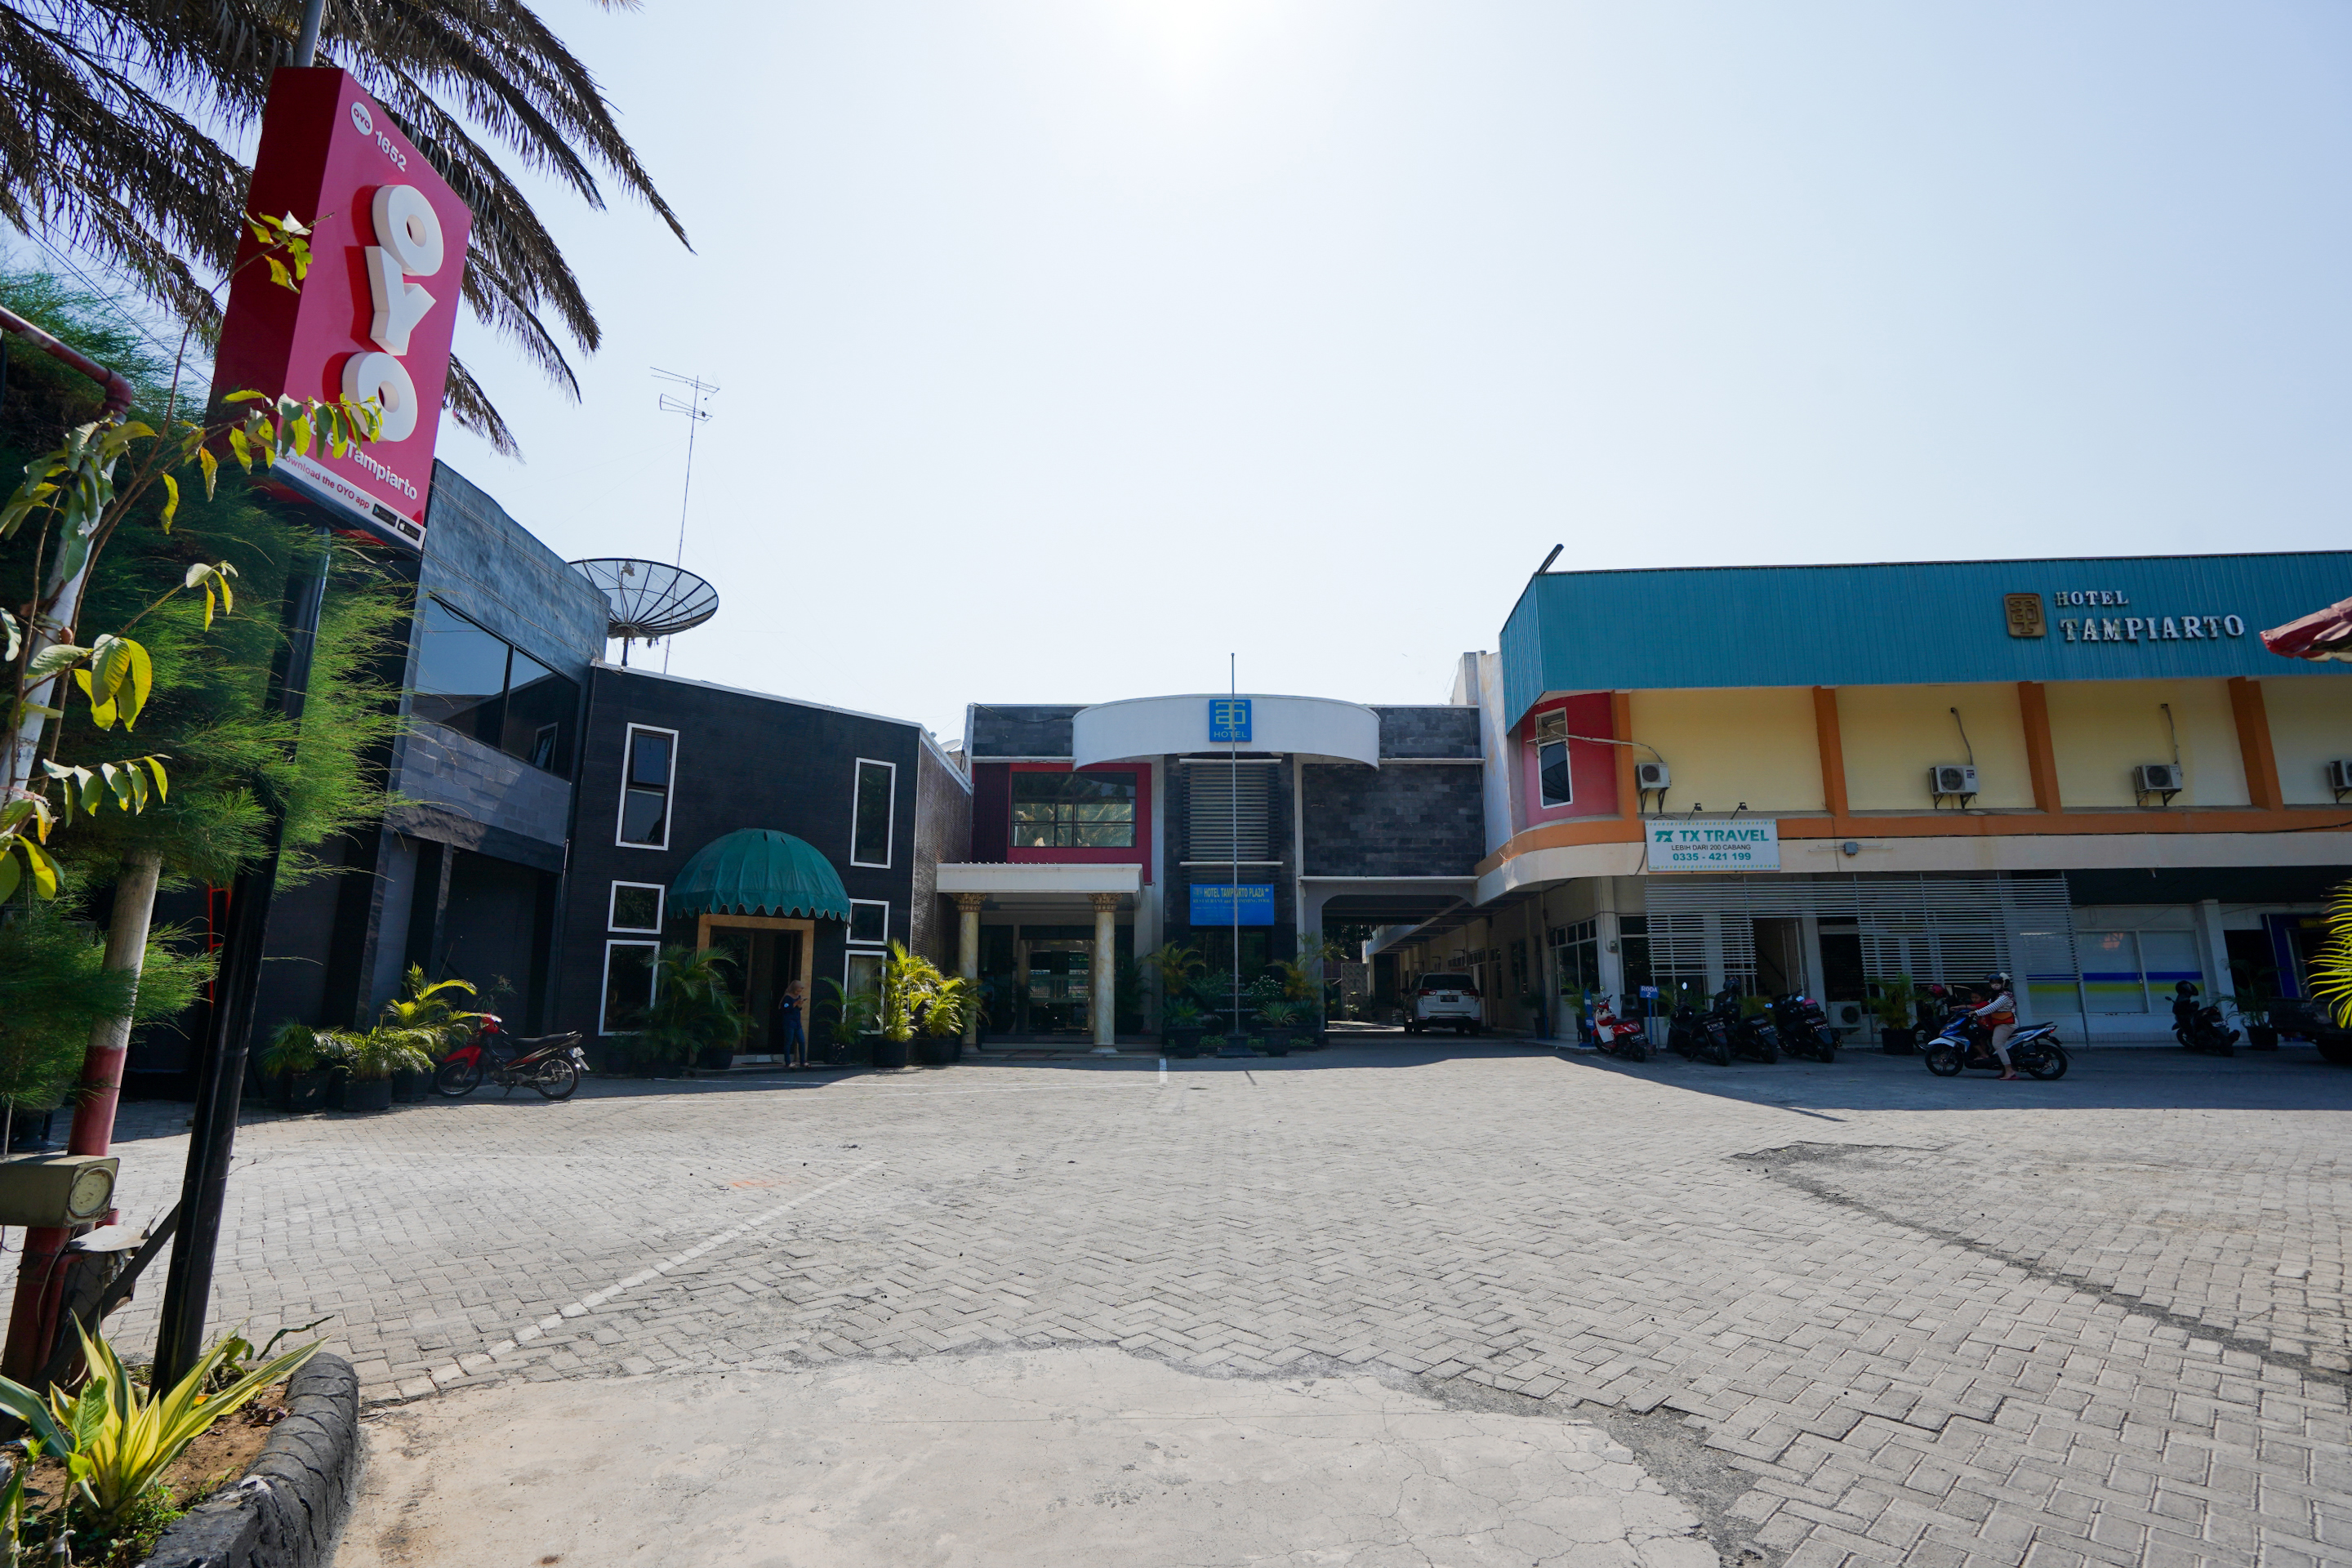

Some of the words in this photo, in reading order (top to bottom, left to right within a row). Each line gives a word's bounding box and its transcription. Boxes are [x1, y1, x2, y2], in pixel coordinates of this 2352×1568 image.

[353, 108, 371, 130] OYO
[375, 130, 407, 172] 1652
[342, 184, 444, 443] OYO
[347, 439, 417, 501] Tampiarto
[322, 475, 335, 489] the
[336, 483, 355, 500] OYO
[355, 496, 370, 510] app
[2055, 590, 2129, 607] HOTEL
[2060, 614, 2245, 641] TAMPIARTO
[1679, 830, 1700, 842] TX
[1704, 830, 1770, 842] TRAVEL
[1673, 853, 1699, 862] 0335
[1708, 853, 1728, 861] 421
[1732, 853, 1752, 861] 199
[1204, 887, 1220, 898] HOTEL
[1221, 887, 1249, 898] TAMPARTO
[1249, 888, 1264, 898] PLAZA
